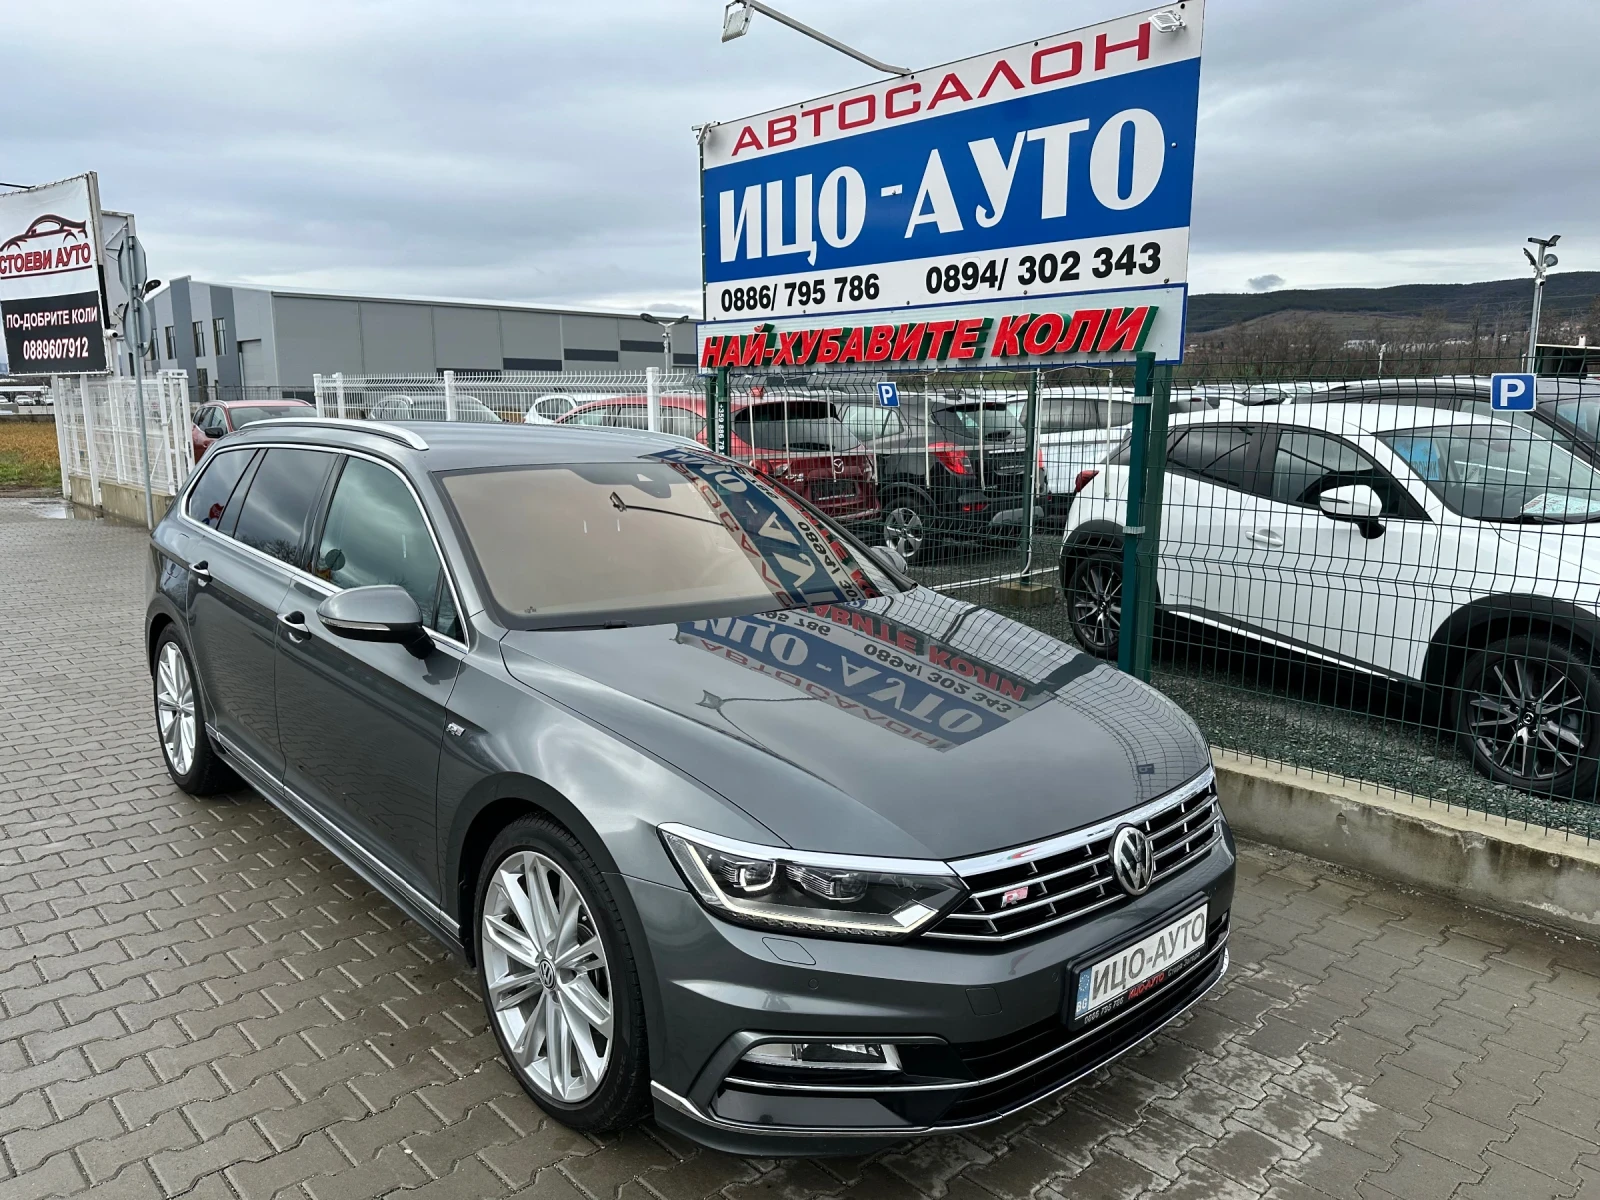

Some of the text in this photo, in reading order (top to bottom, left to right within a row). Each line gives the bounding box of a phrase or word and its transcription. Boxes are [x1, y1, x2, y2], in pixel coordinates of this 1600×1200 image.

[731, 22, 1151, 156] АВТОСАЛОН
[0, 242, 91, 274] СТОЕВИ АУТО
[925, 242, 1161, 294] 0894/ 302 343
[720, 273, 880, 313] 0886/ 795 786
[6, 306, 98, 331] ПО-ДОБРИТЕ КОЛИ
[23, 336, 89, 360] 0889607912
[700, 305, 1152, 369] НАЙ-ХУБАВИТЕ КОЛИ
[881, 386, 892, 404] P
[1500, 379, 1525, 406] P
[1092, 912, 1205, 1001] ИЦО-АУТО
[1076, 997, 1088, 1013] BG
